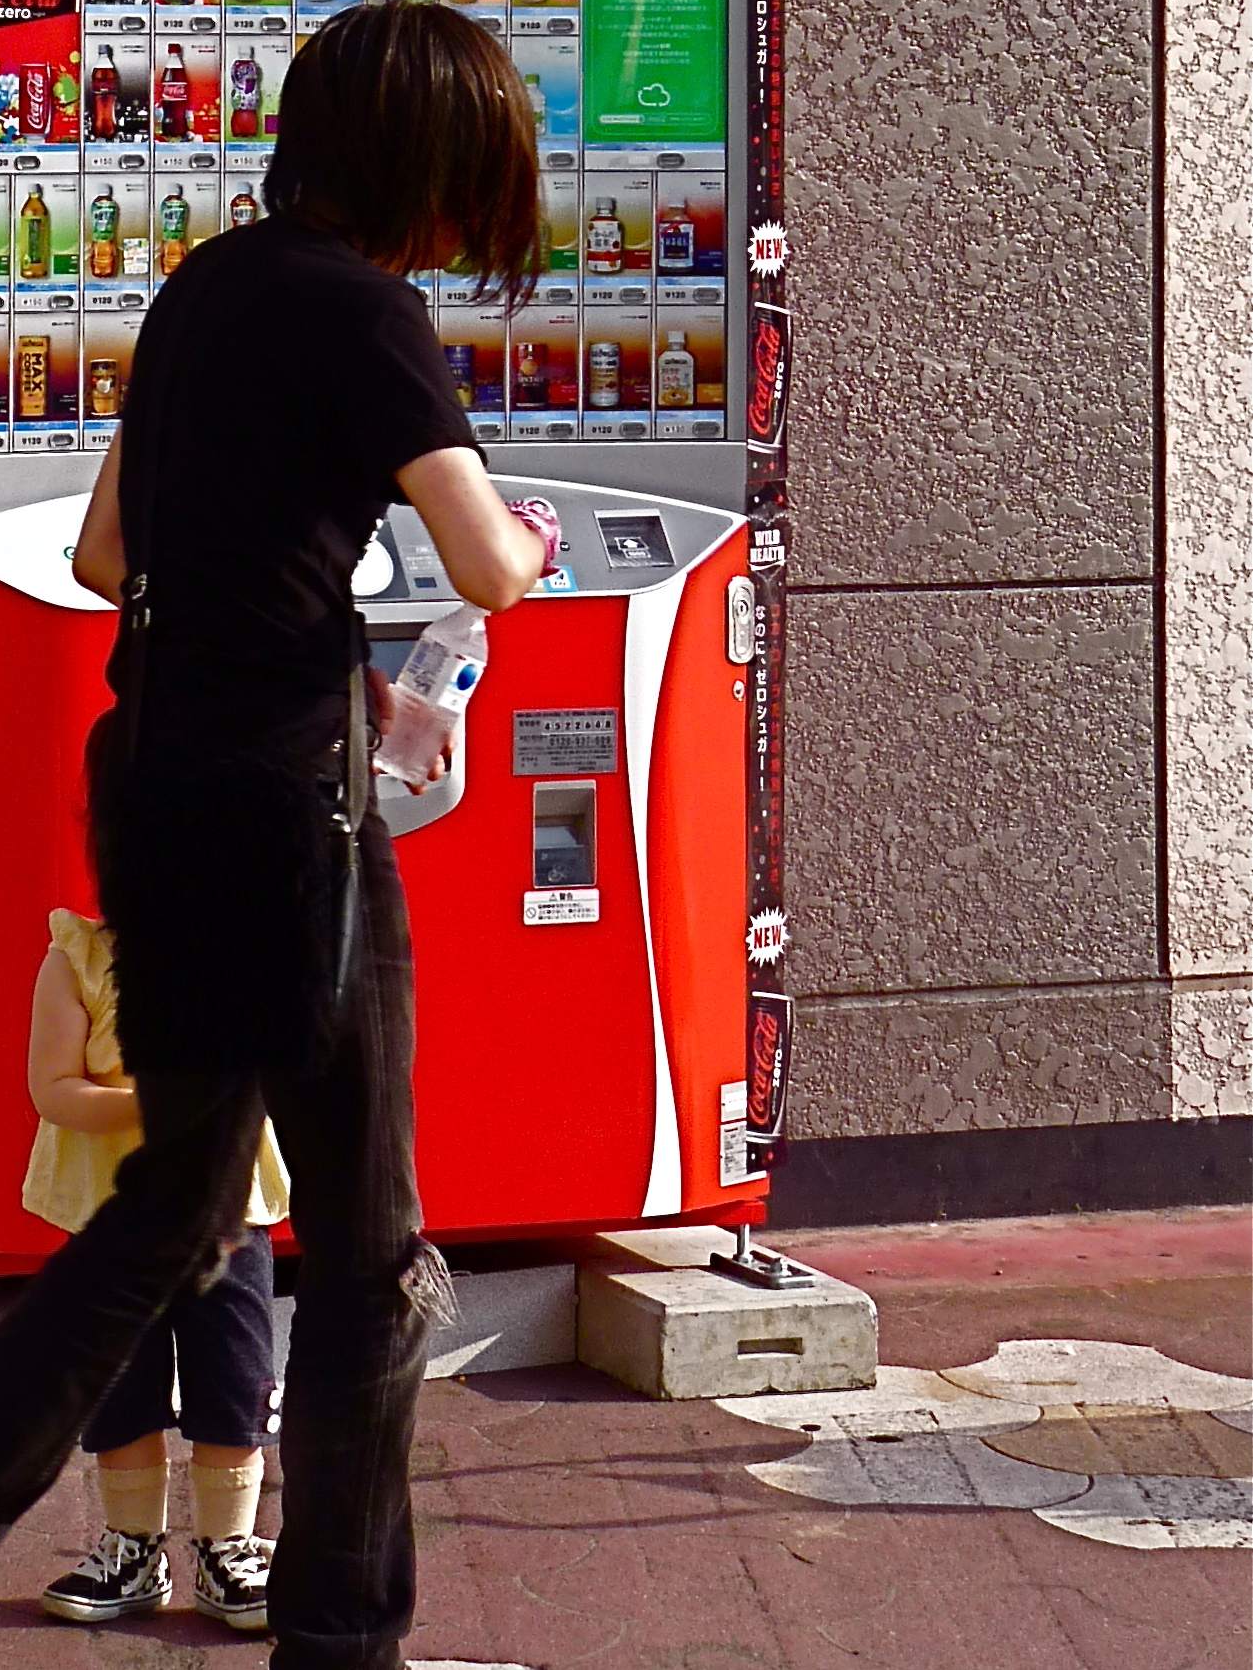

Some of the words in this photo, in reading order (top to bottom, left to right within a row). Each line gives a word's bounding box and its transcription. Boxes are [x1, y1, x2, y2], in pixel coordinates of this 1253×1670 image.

[755, 237, 783, 260] NEW
[31, 352, 43, 392] MAX
[774, 362, 785, 400] zero
[754, 530, 781, 547] WILD
[750, 546, 786, 564] HEALTH
[753, 924, 782, 949] NEW
[772, 1049, 783, 1087] zero
